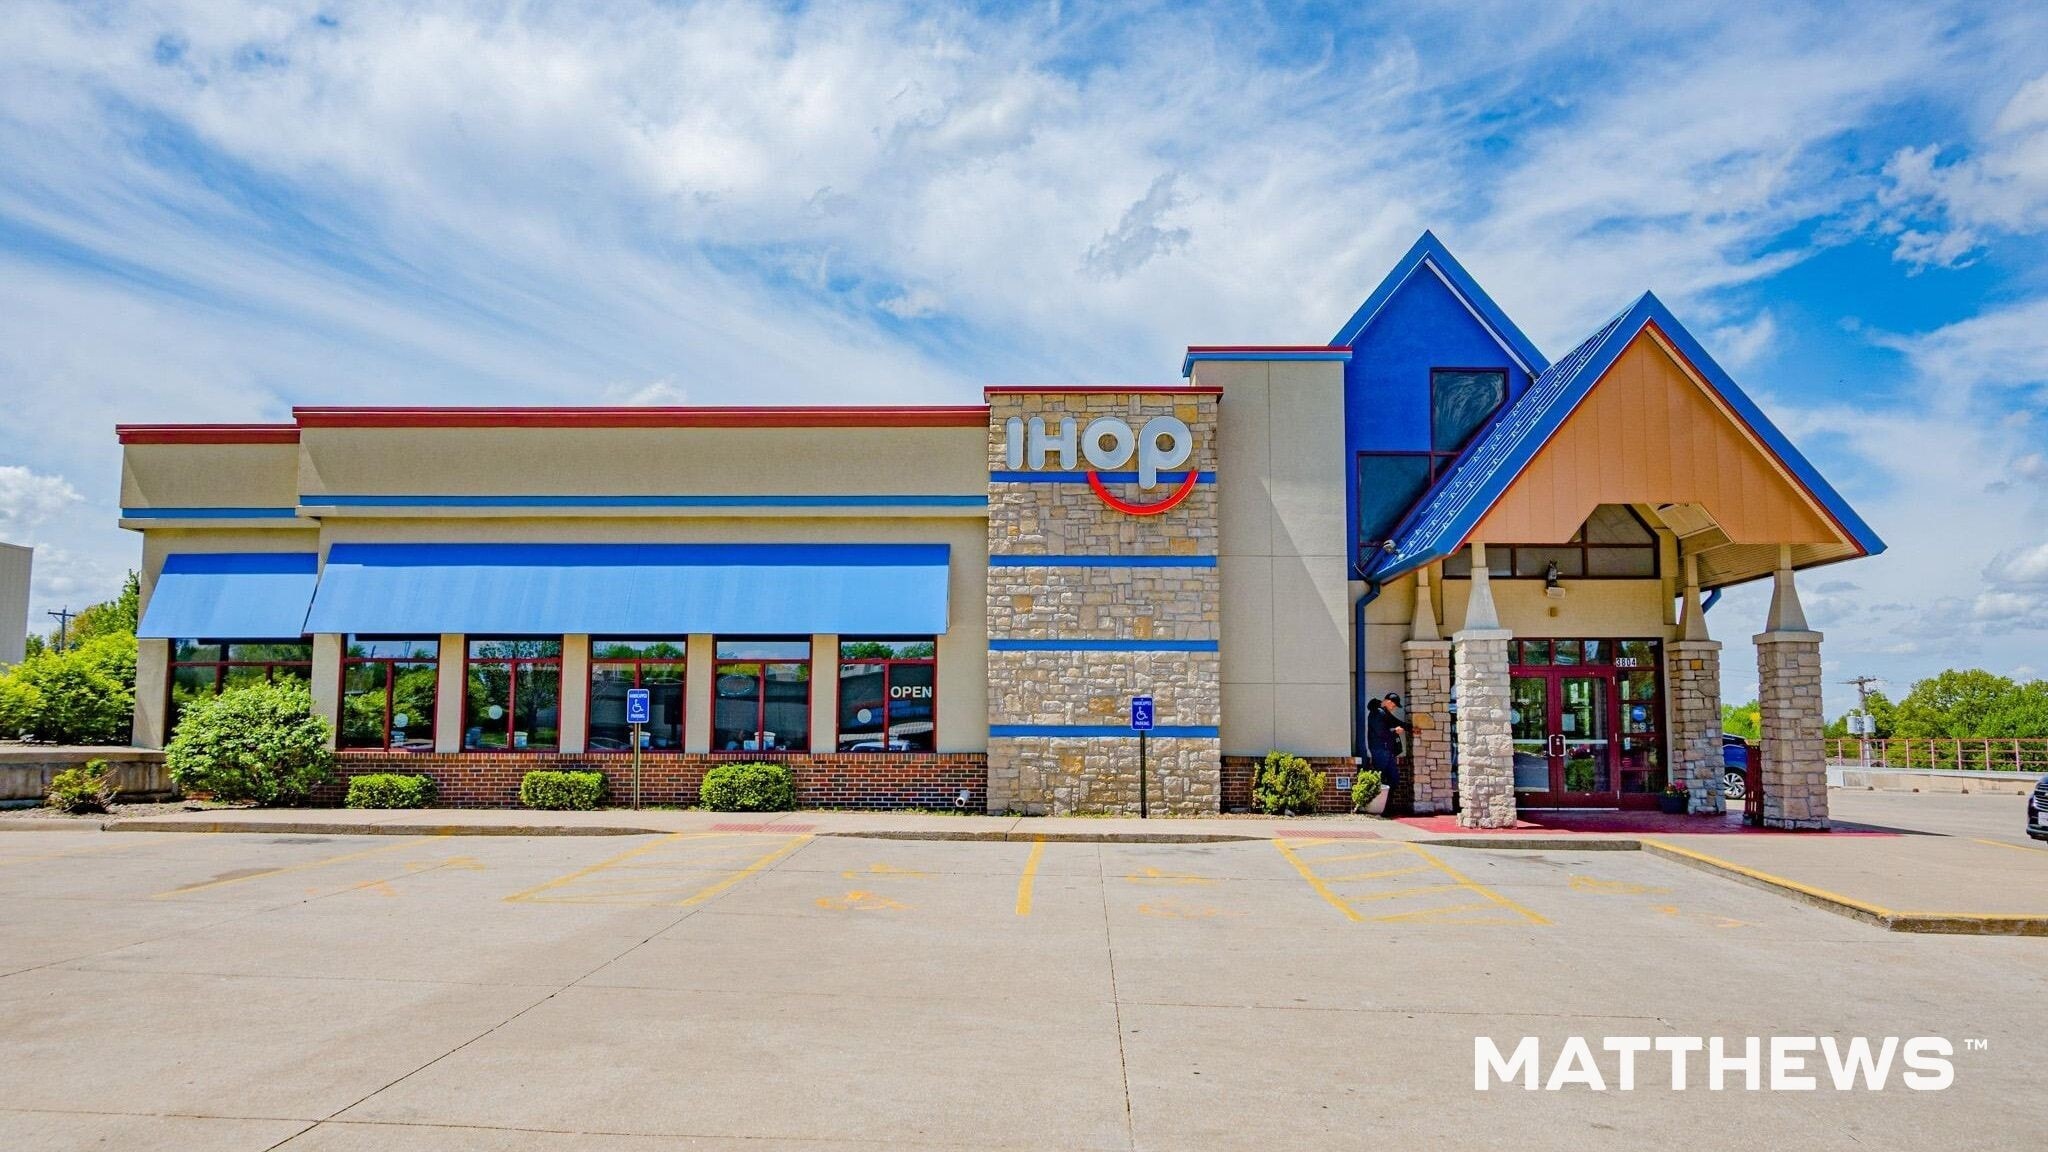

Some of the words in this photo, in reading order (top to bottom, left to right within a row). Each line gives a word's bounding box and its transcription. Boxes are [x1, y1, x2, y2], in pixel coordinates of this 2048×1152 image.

[1005, 415, 1193, 490] IHOP
[1616, 658, 1636, 667] 3804
[891, 686, 932, 698] OPEN
